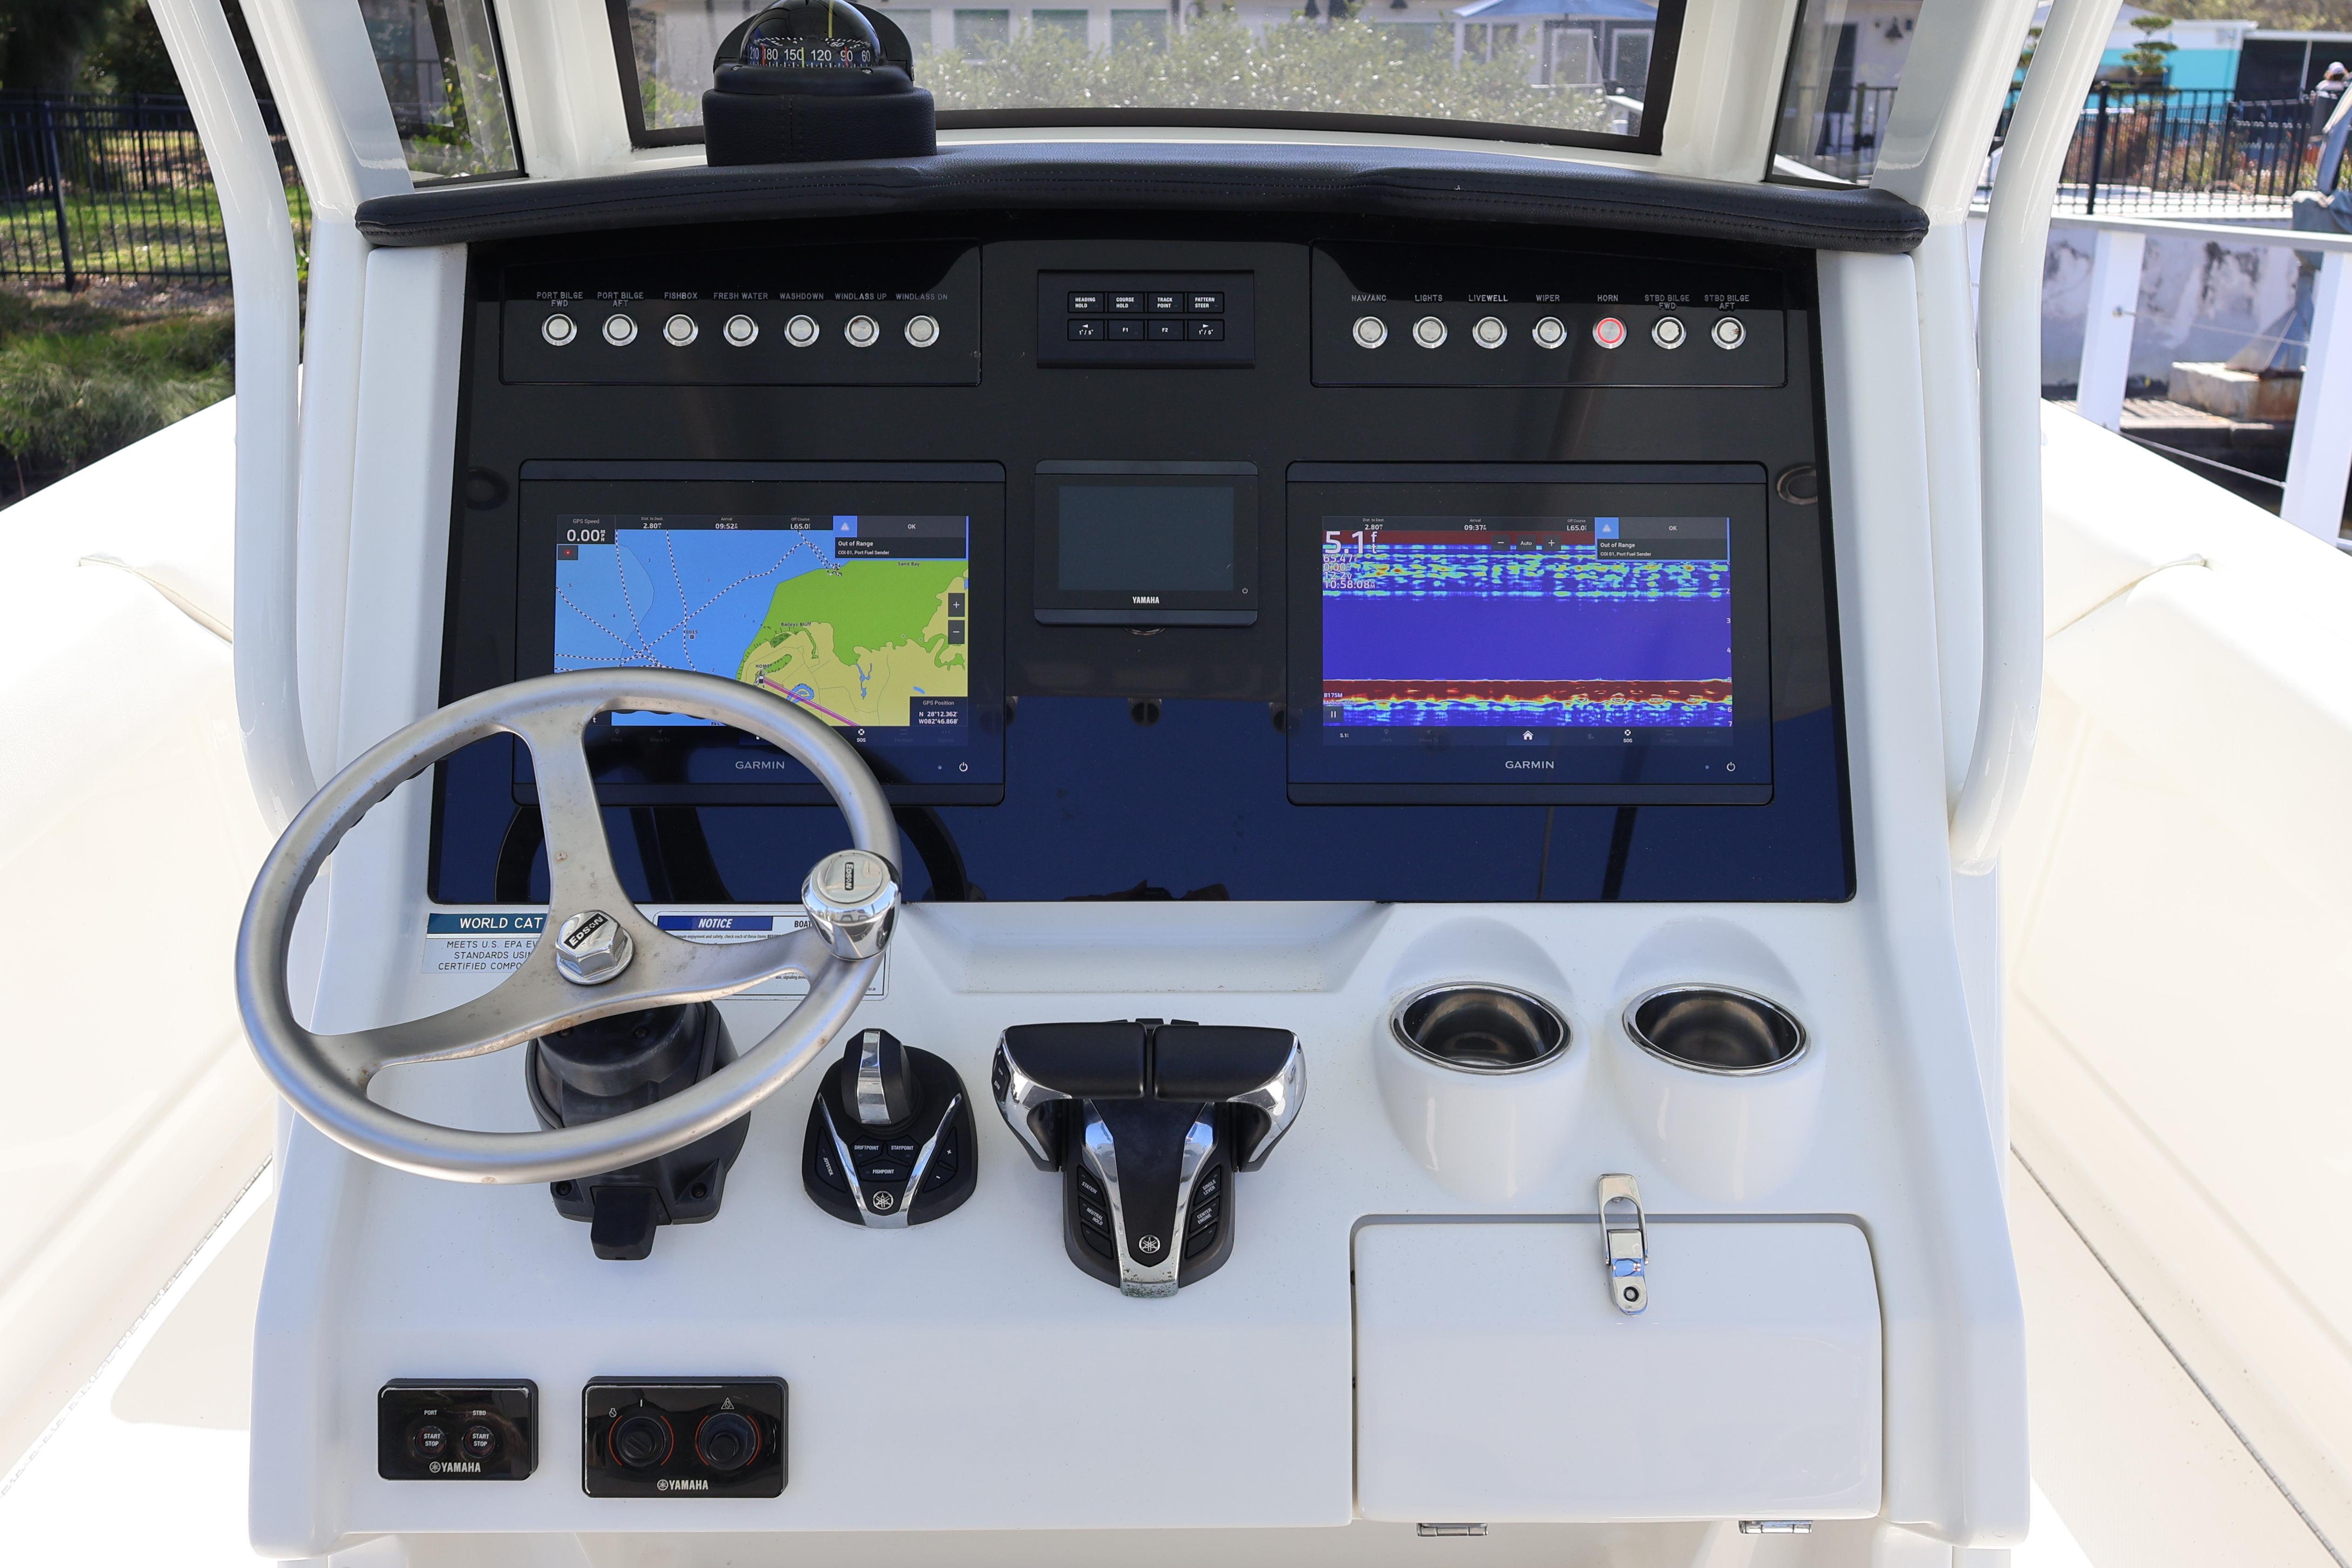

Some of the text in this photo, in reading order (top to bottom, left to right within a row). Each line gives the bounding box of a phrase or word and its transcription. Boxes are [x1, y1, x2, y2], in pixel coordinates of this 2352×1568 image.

[750, 48, 871, 62] 210 180 150 120 90 60
[567, 529, 600, 542] 0.00
[1325, 531, 1364, 554] 5.1
[735, 761, 785, 769] GARMIN
[1505, 761, 1554, 770] GARMIN
[845, 864, 854, 889] EDSON
[460, 918, 543, 928] WORLD CAT
[698, 919, 733, 928] NOTICE
[569, 915, 604, 946] EDSON
[823, 1157, 834, 1176] JOYSTICK
[1081, 1181, 1098, 1194] STATION
[1202, 1179, 1217, 1190] SINGLE
[1203, 1185, 1216, 1196] LEVER
[1086, 1207, 1103, 1221] NEUTRAL
[1197, 1207, 1212, 1219] CENTER
[1197, 1213, 1212, 1224] ENGINE
[1092, 1217, 1103, 1226] HOLD
[441, 1462, 481, 1473] YAMAHA
[669, 1480, 709, 1490] YAMAHA
